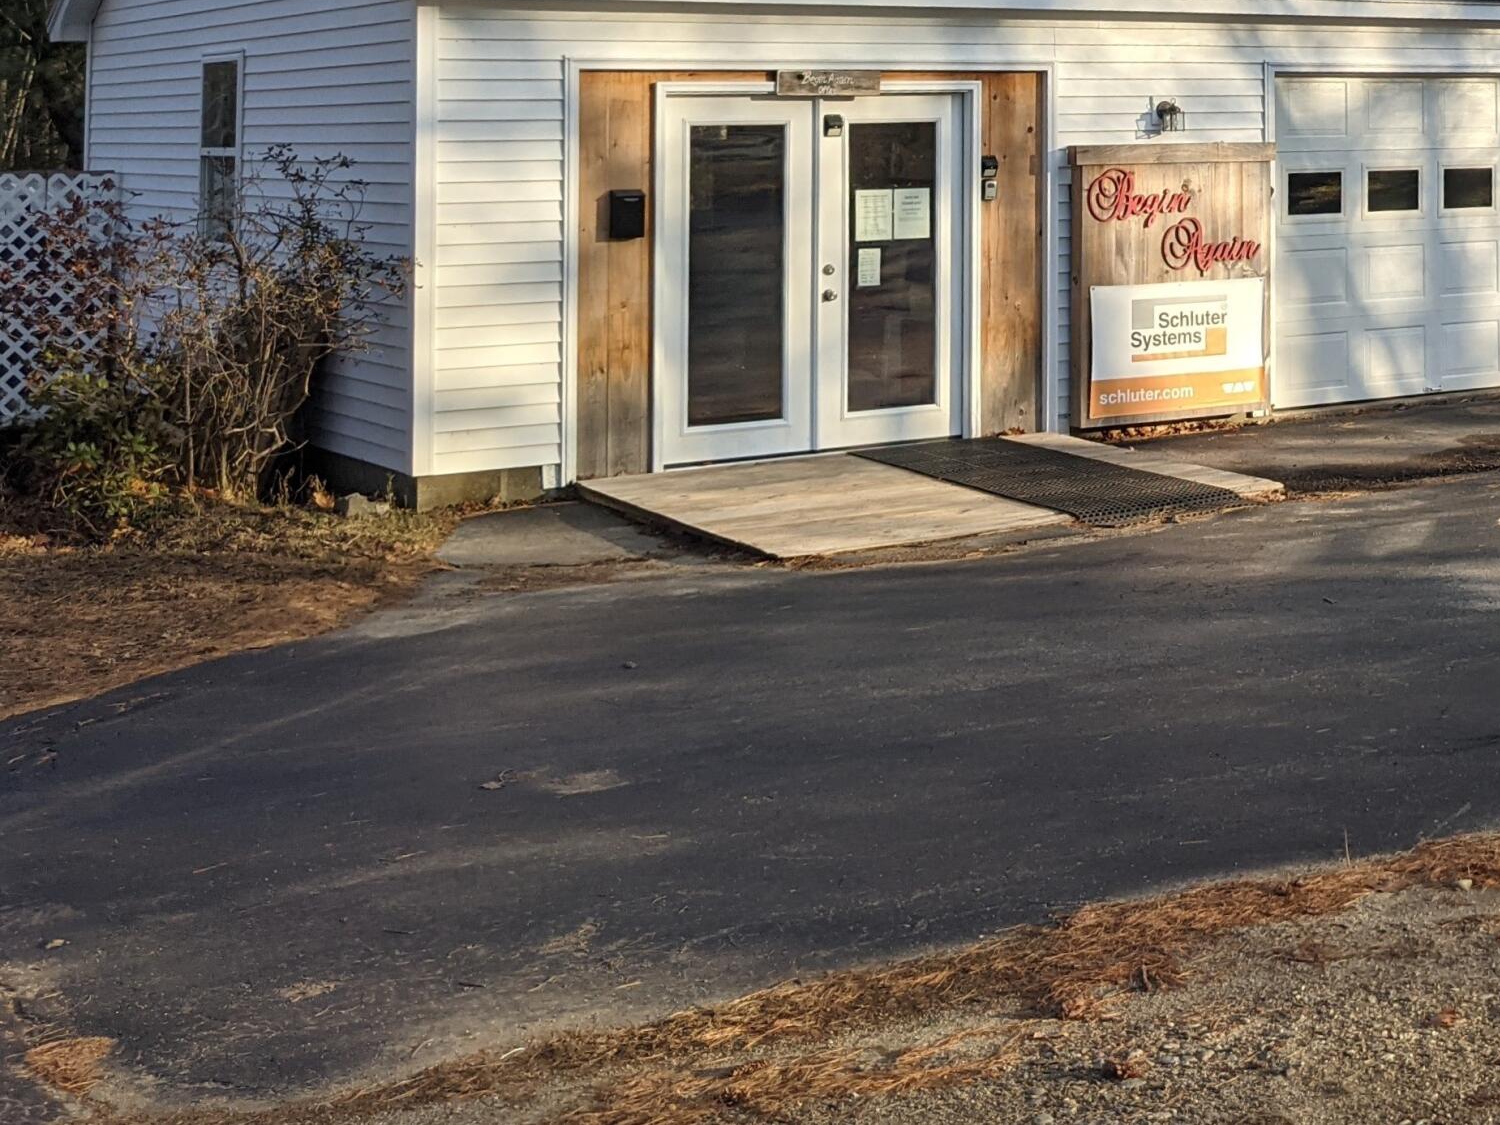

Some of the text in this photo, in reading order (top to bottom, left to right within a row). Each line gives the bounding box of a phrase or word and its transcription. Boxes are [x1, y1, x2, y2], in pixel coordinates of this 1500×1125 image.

[1087, 168, 1191, 228] Begin
[1161, 217, 1260, 277] Again
[1158, 311, 1227, 328] Schluter
[1130, 329, 1202, 351] Systems
[1099, 386, 1194, 405] schluter.com
